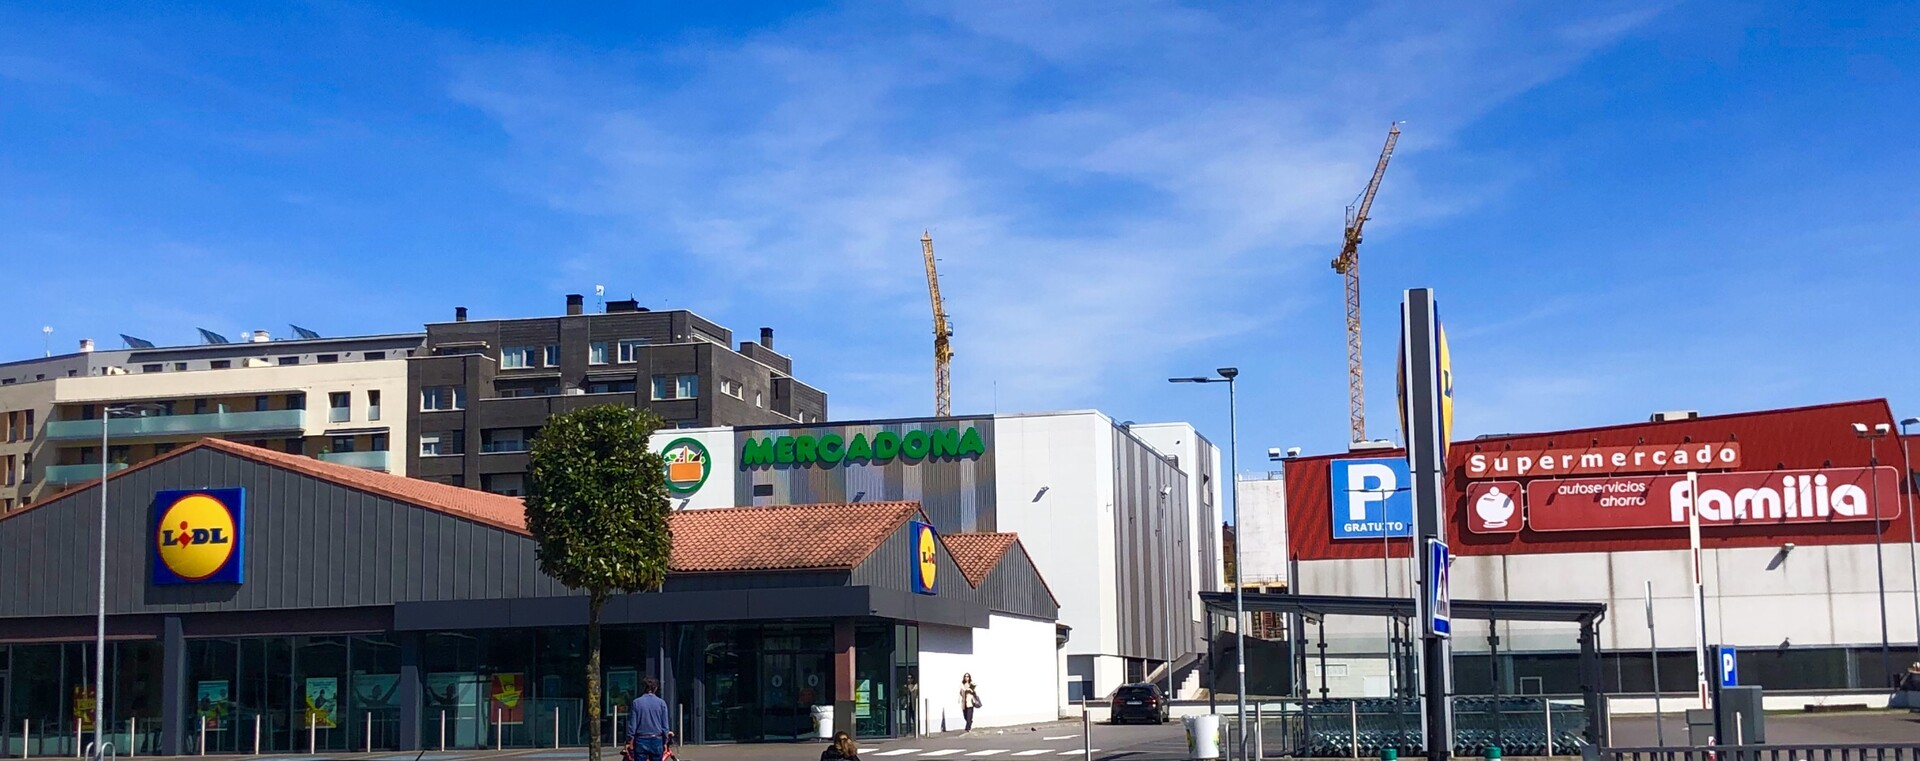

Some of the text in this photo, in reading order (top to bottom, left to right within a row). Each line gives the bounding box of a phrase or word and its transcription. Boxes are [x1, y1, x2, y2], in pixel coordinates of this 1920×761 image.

[742, 426, 986, 466] MERCADONA
[1470, 445, 1736, 475] Supermercado
[1348, 463, 1397, 520] P
[1557, 480, 1646, 496] autoservicios
[1599, 494, 1646, 508] ahorro
[1722, 653, 1734, 682] P
